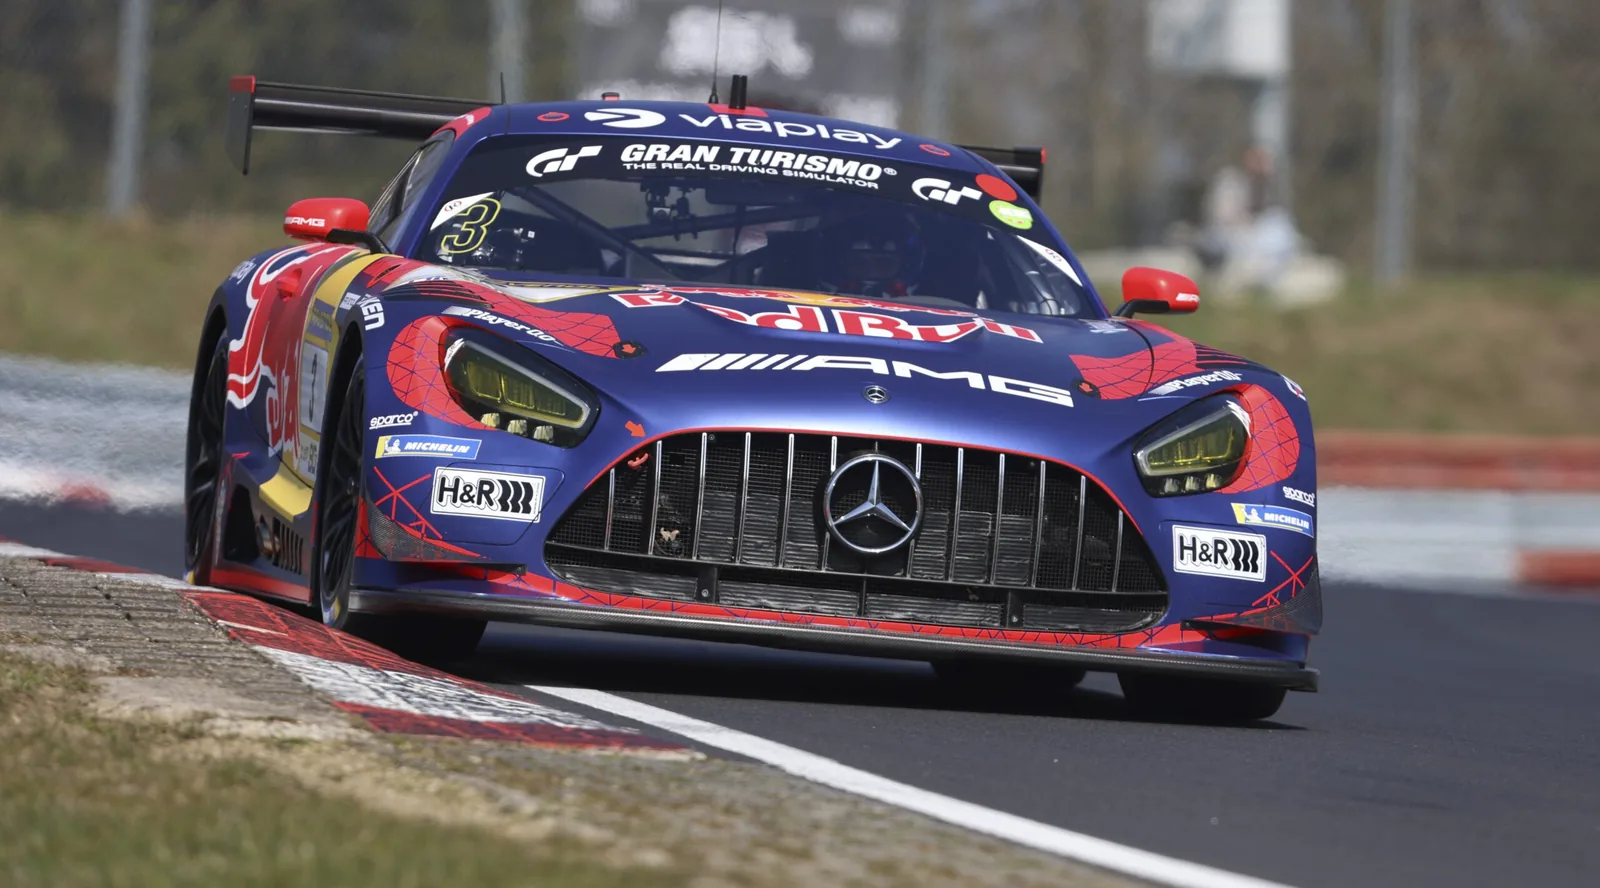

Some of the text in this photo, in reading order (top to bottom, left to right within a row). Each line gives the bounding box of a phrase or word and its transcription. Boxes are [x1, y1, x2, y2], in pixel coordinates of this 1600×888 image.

[678, 113, 902, 149] viaplay
[620, 143, 721, 162] GRAN
[622, 162, 879, 190] THE REAL DRIVING SIMULATOR
[290, 216, 326, 228] AMG
[440, 197, 502, 254] 3
[792, 353, 1074, 408] AMG
[369, 411, 415, 429] sparco
[403, 439, 471, 454] MICHELIN
[437, 475, 497, 509] H&R
[1263, 512, 1310, 529] MICHELIN
[1178, 534, 1230, 566] H&R
